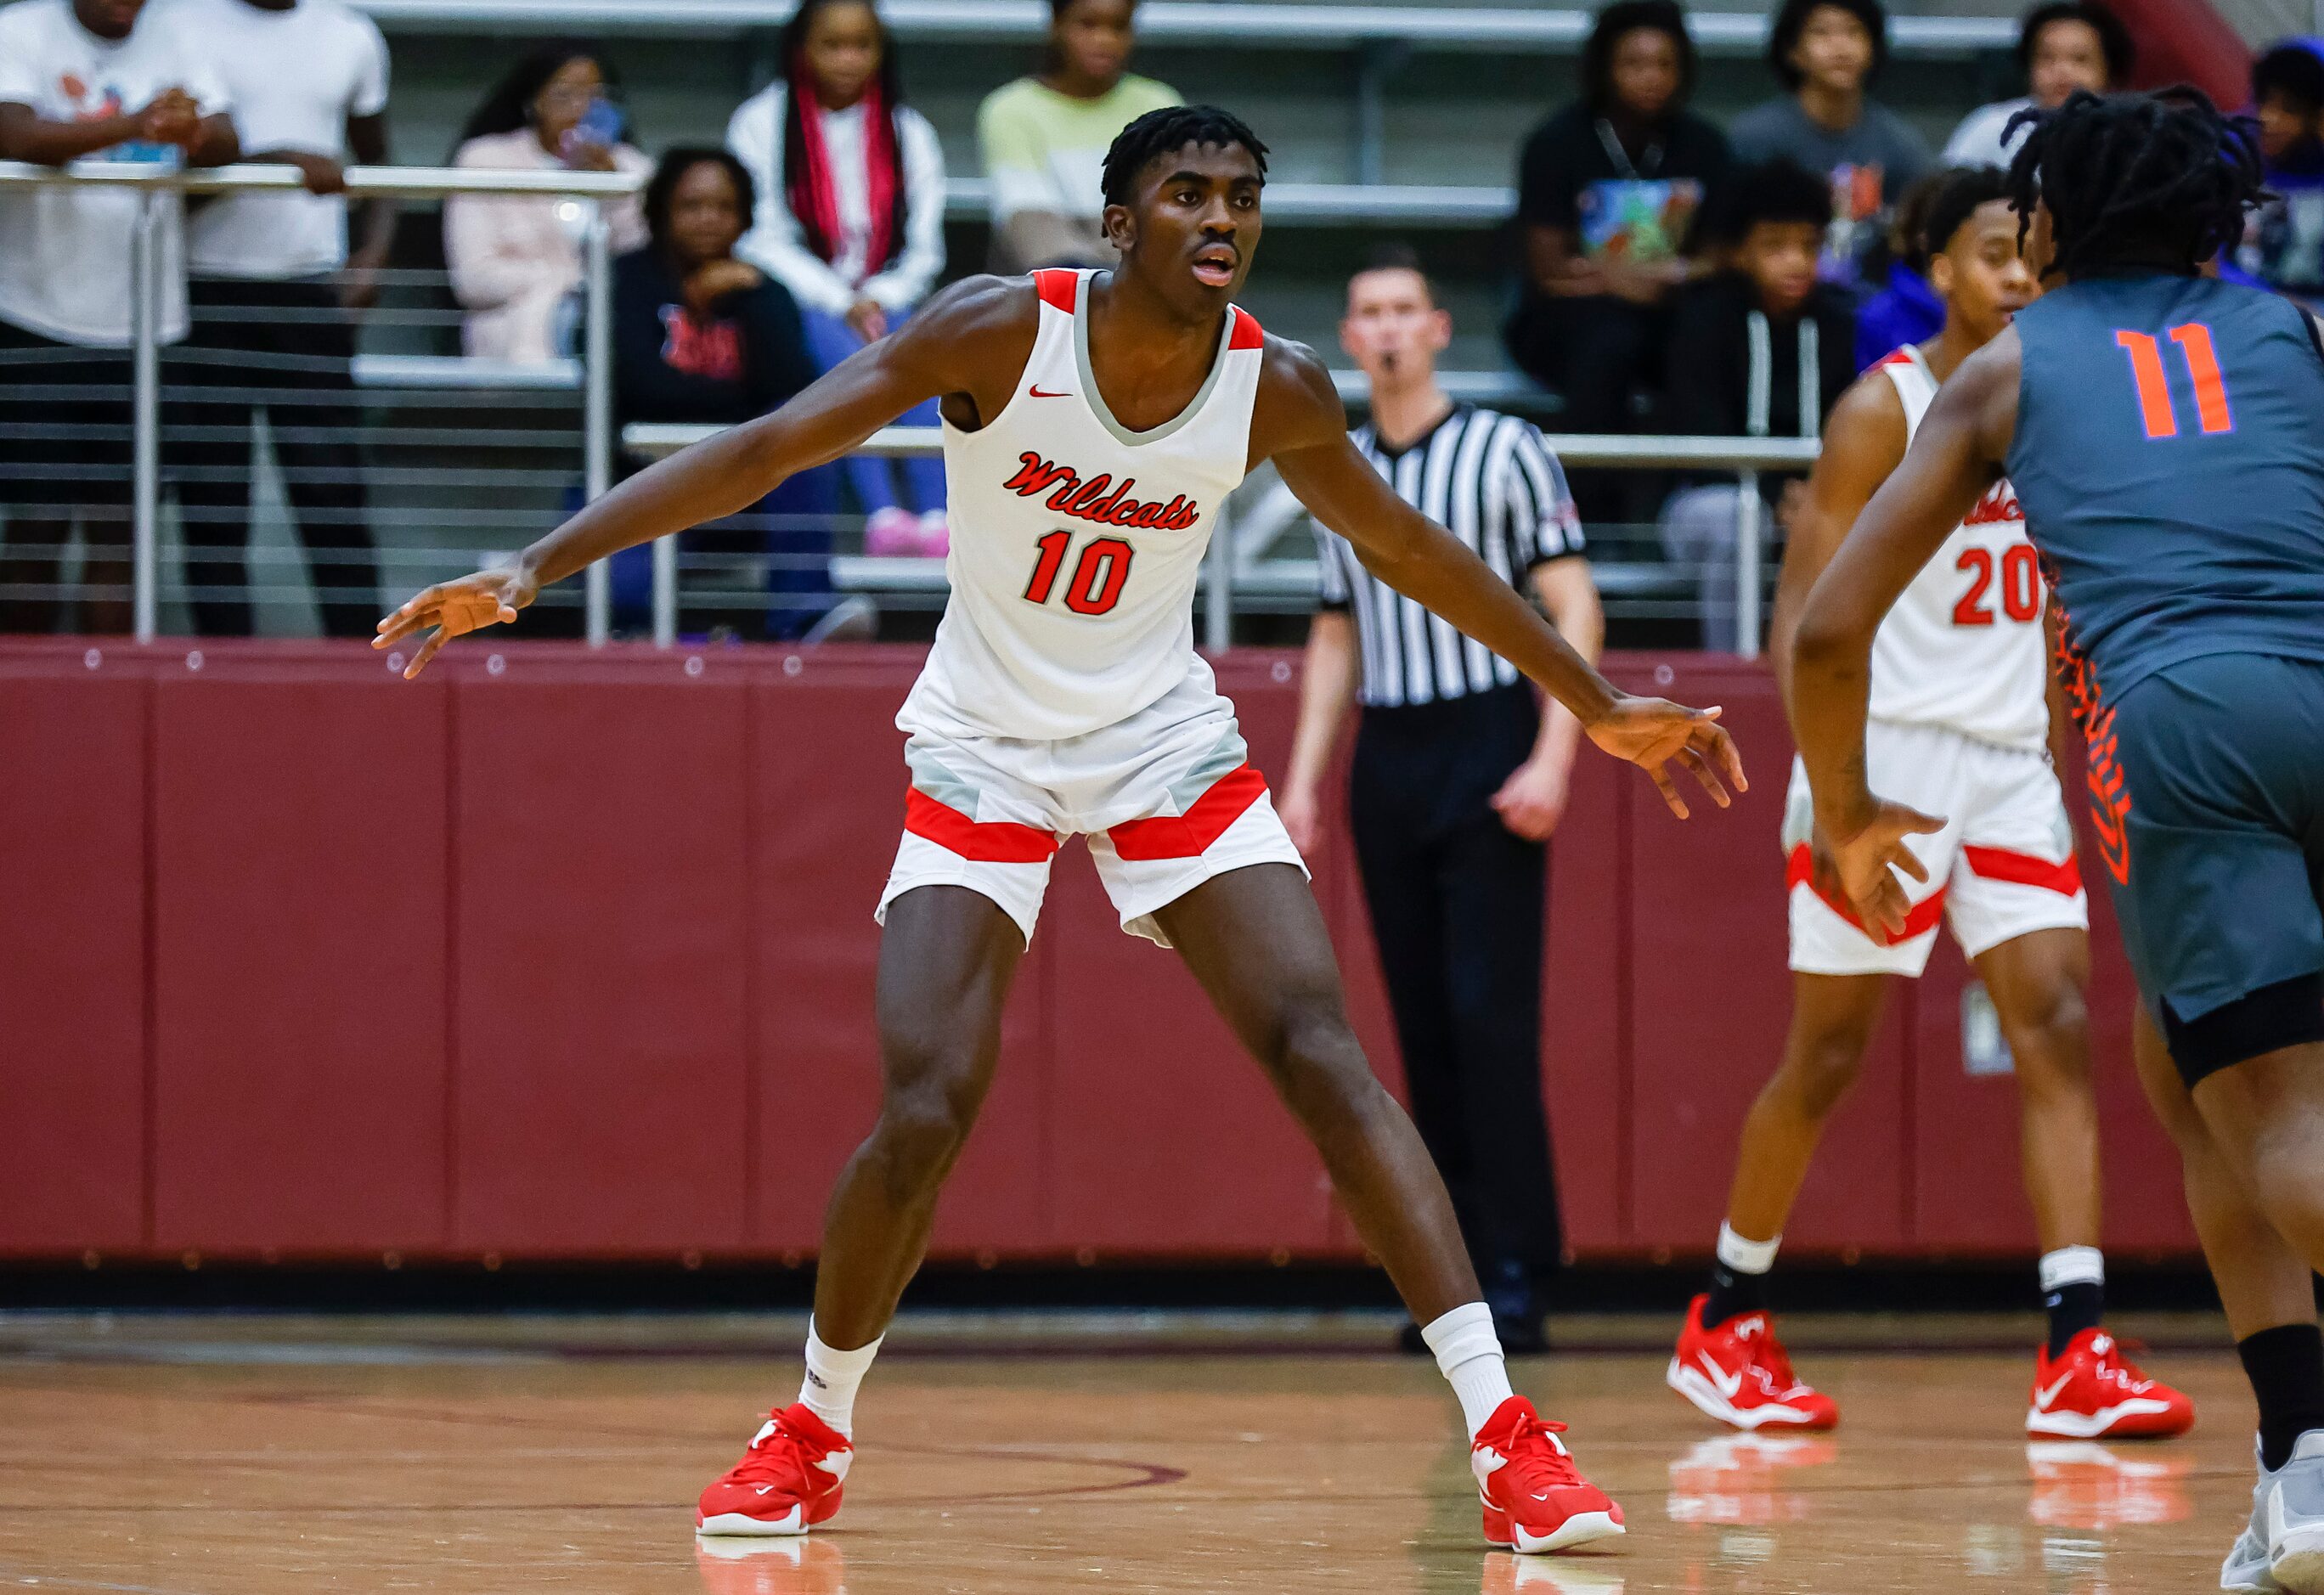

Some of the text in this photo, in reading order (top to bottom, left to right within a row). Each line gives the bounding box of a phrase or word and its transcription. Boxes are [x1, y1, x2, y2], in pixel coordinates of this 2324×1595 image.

[2115, 322, 2232, 438] 11
[1002, 451, 1199, 530] Wildcats
[1023, 528, 1136, 616] 10
[1953, 544, 2039, 625] 20
